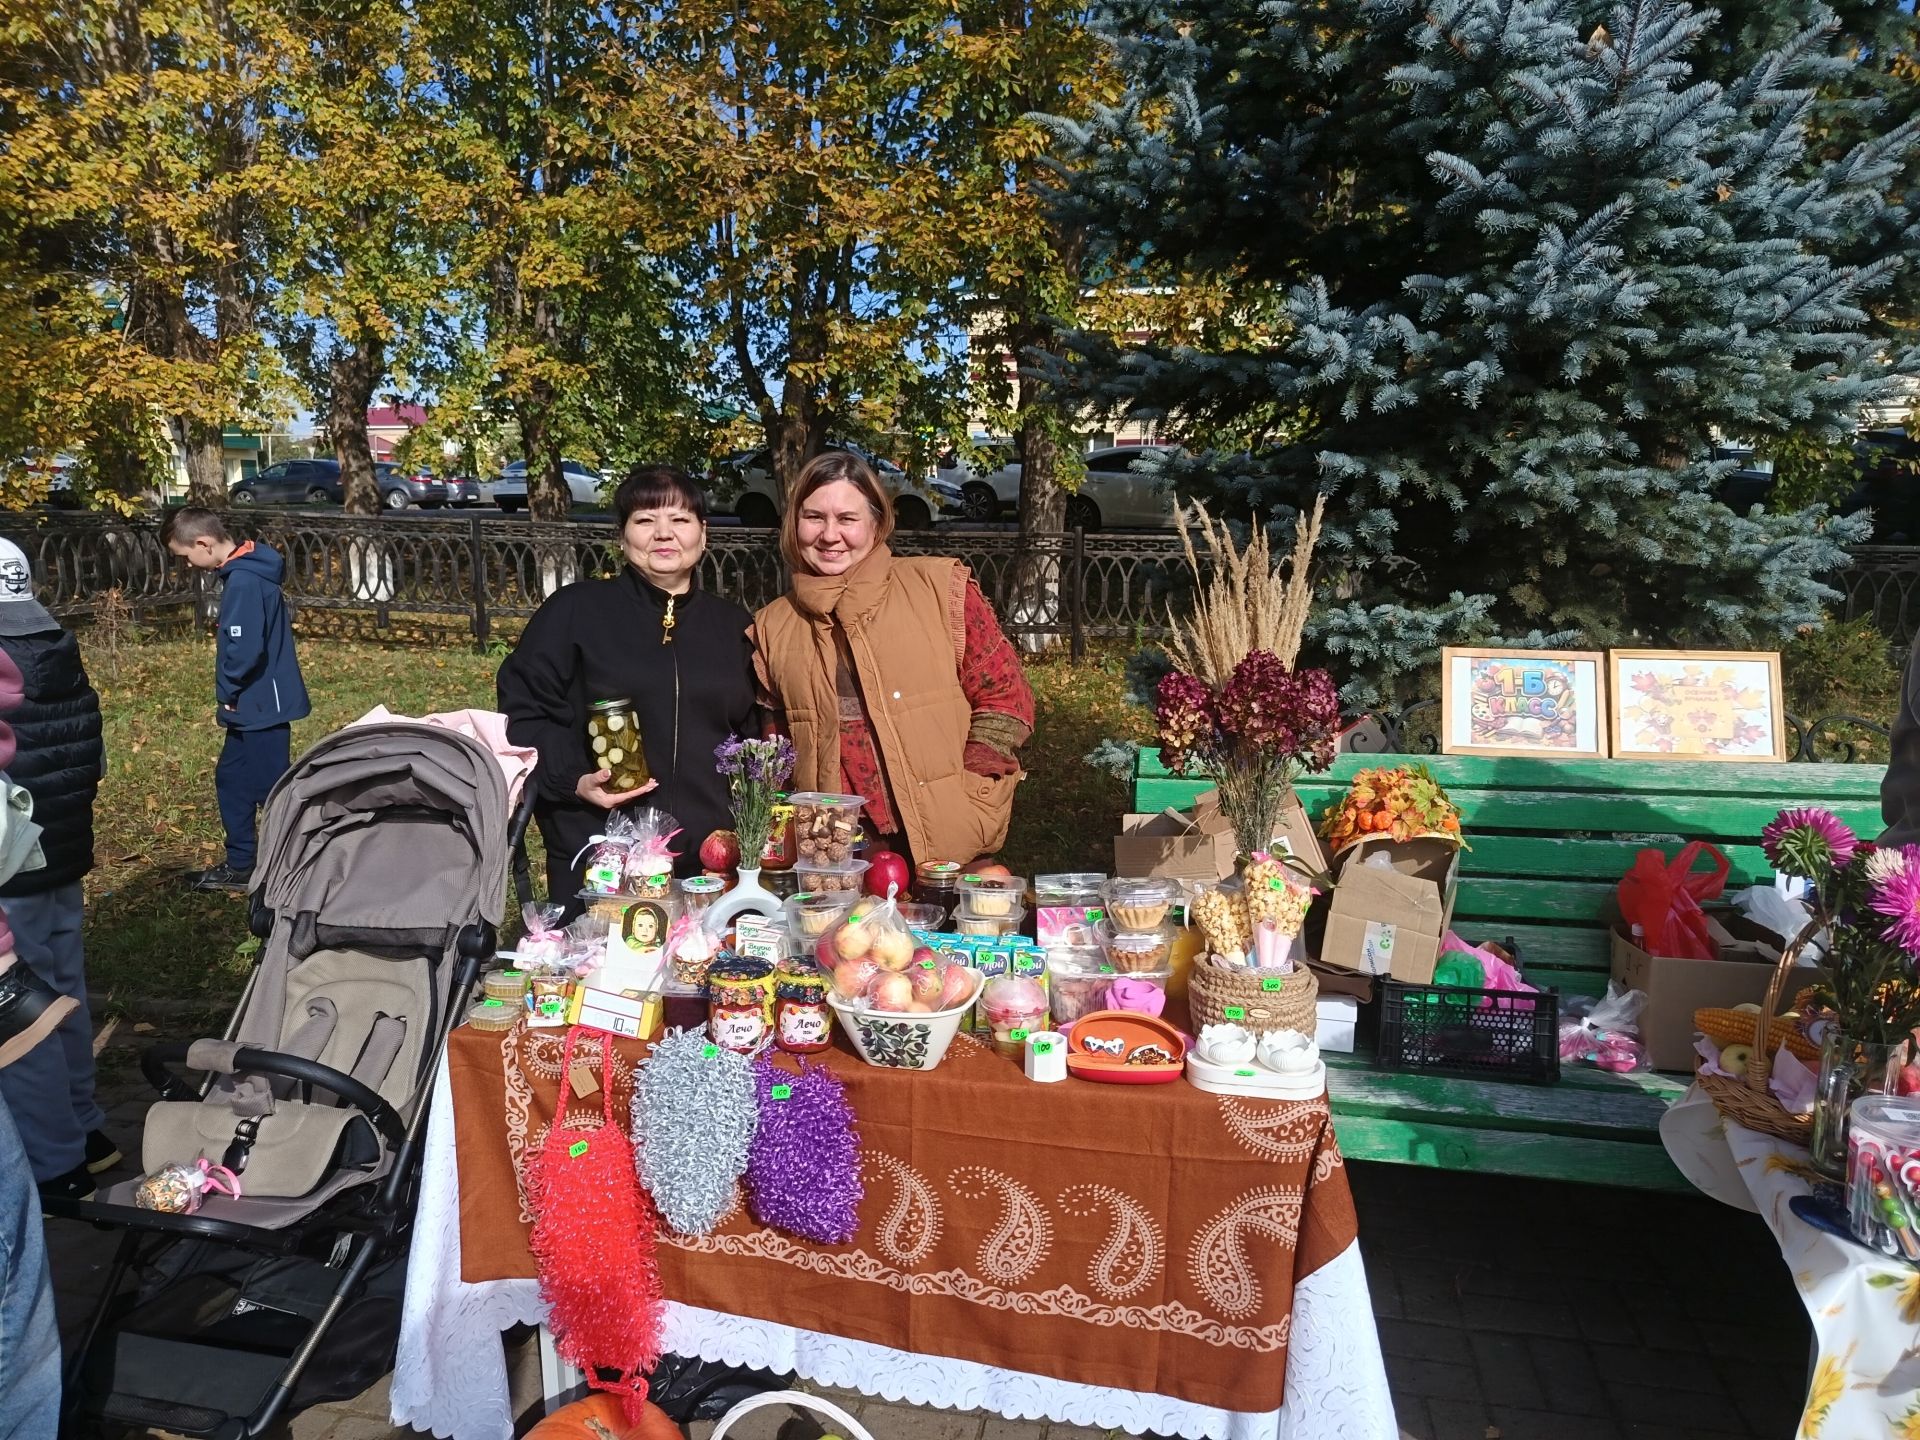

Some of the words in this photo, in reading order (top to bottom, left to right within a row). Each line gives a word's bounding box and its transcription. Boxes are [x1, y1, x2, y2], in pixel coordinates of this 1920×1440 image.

[1494, 668, 1546, 696] 1-Б
[1488, 696, 1557, 719] КЛАСС
[725, 1023, 753, 1034] Лечо
[794, 1018, 821, 1029] Лечо
[1037, 1043, 1051, 1052] 100
